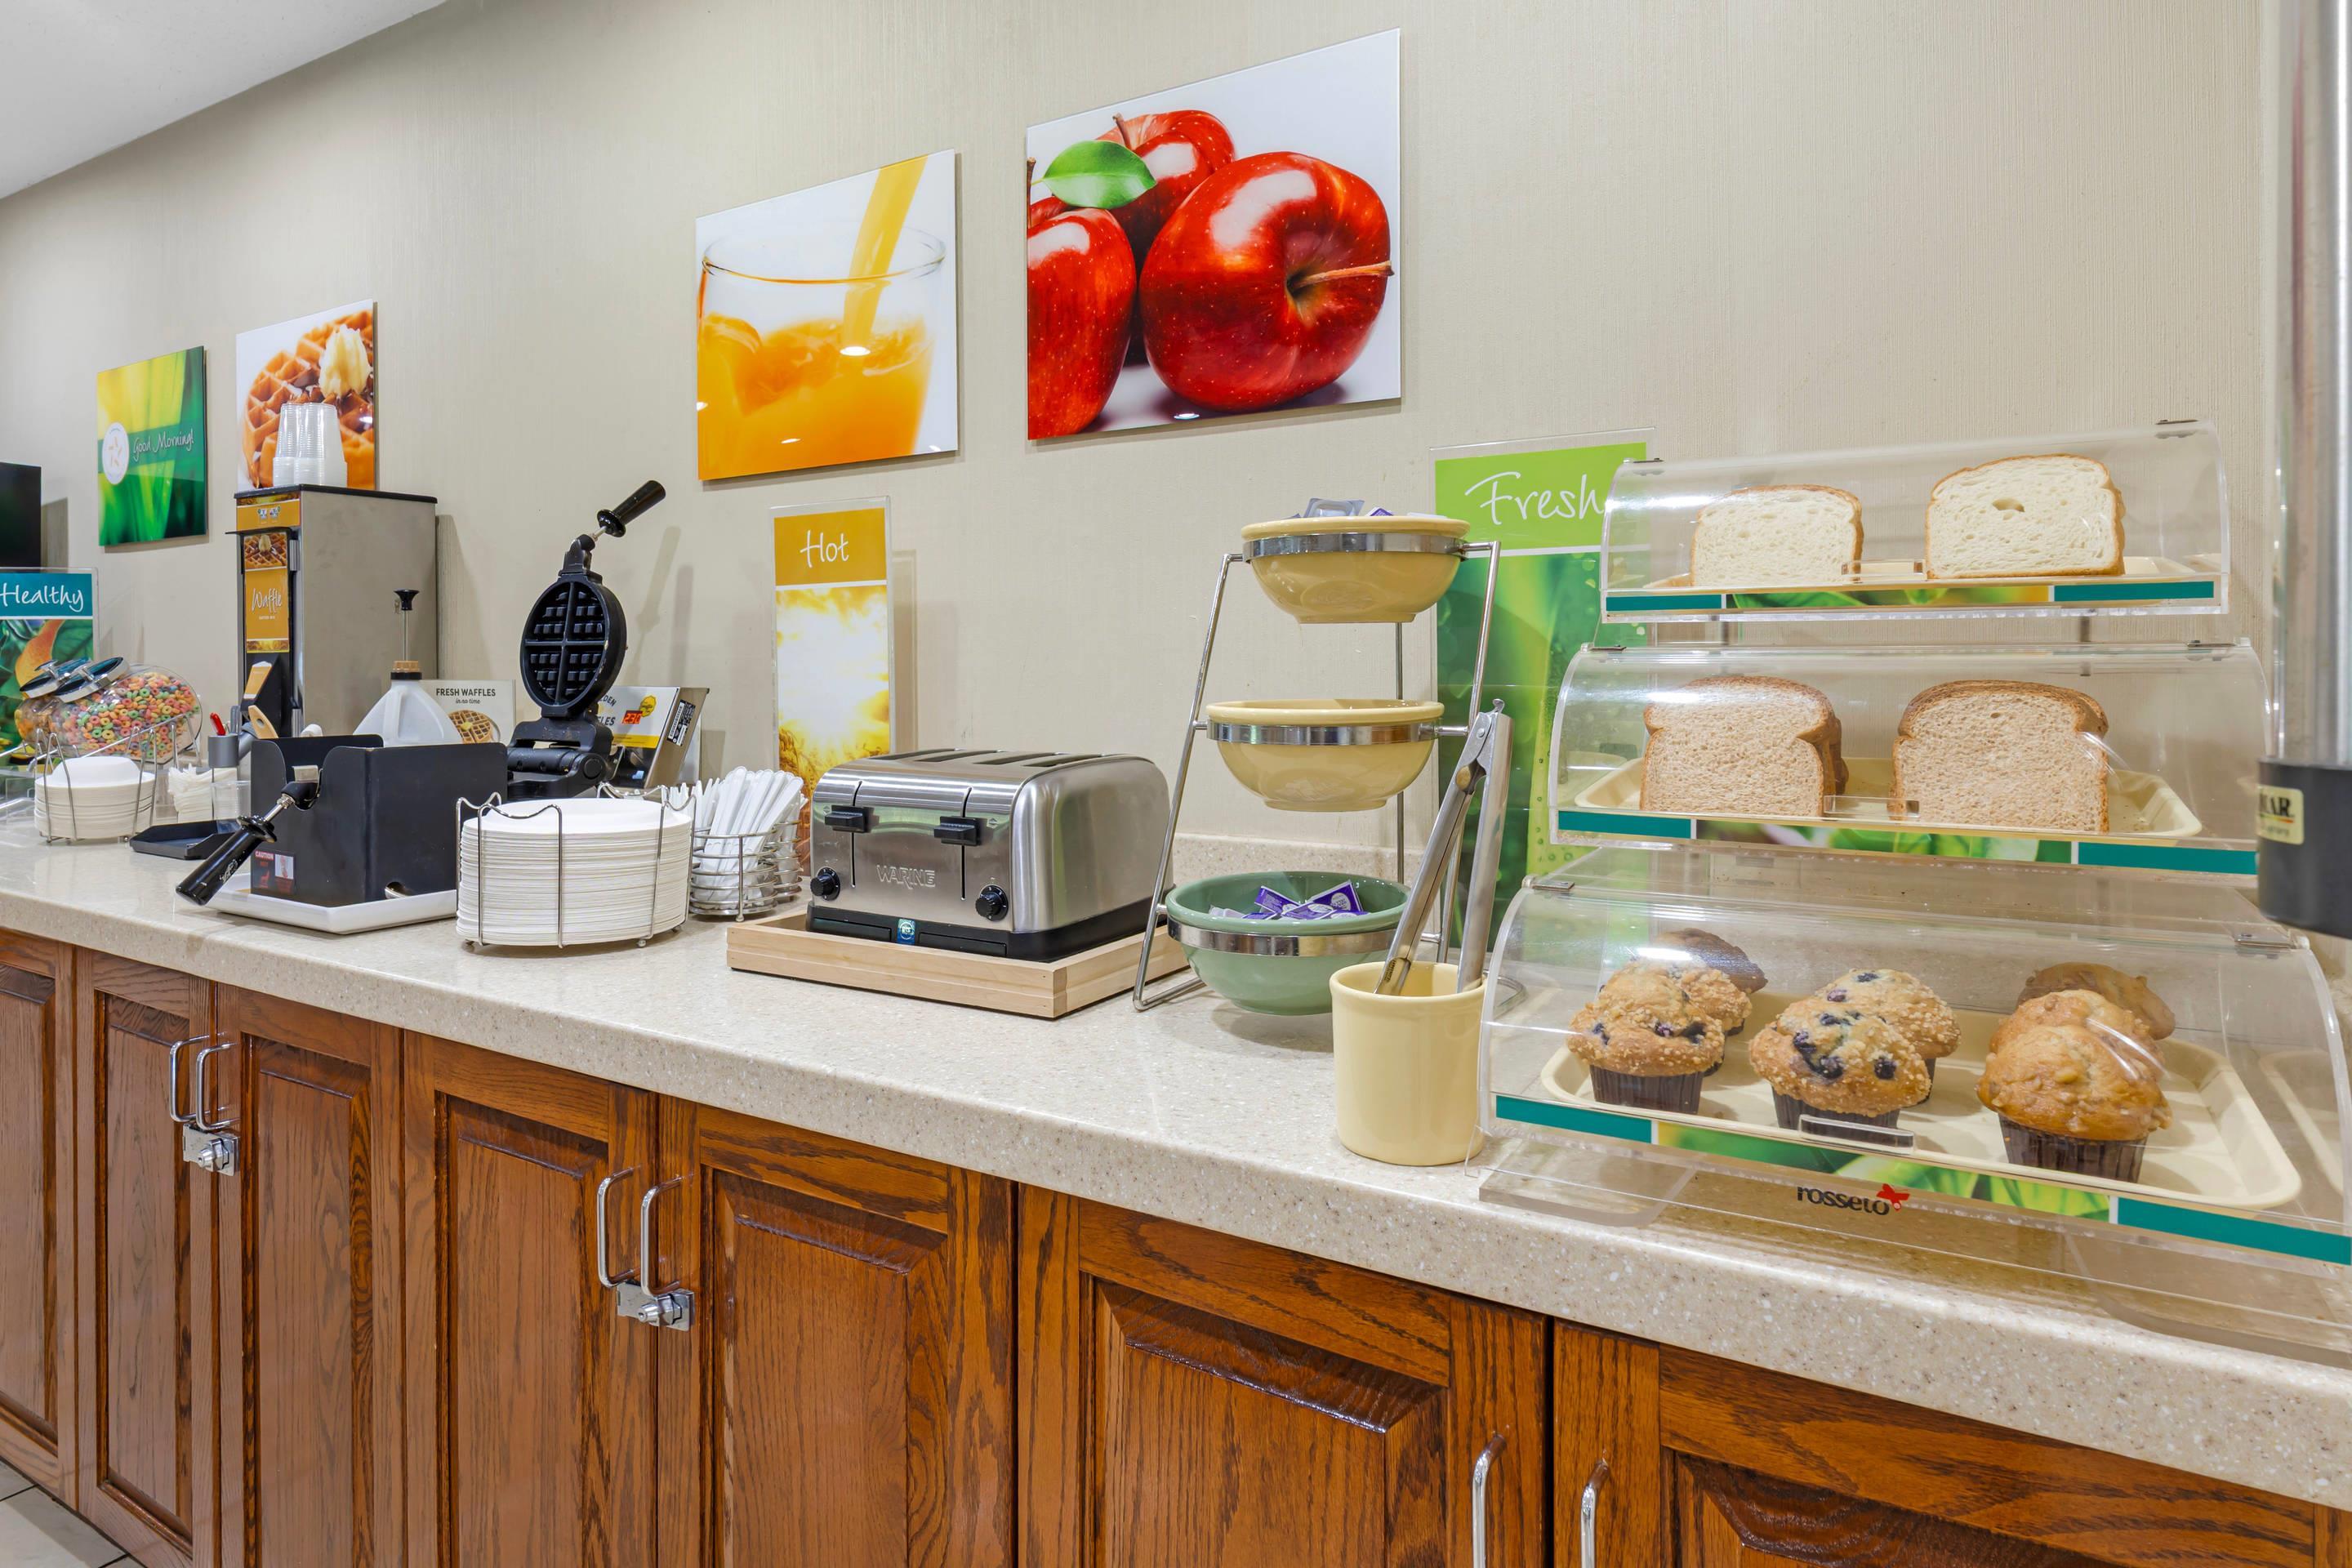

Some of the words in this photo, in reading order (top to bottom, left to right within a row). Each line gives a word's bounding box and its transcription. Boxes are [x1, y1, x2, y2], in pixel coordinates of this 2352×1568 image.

[133, 436, 152, 461] Good
[153, 428, 194, 452] Morning!
[1464, 471, 1605, 525] Fresh
[800, 529, 849, 568] Hot
[0, 582, 84, 612] Healthy
[252, 588, 283, 613] Waffle
[436, 688, 460, 697] FRESH
[461, 688, 497, 697] WAFFLES
[602, 694, 617, 707] DEN
[876, 864, 936, 889] WARING
[1797, 1186, 1891, 1216] rosseto
